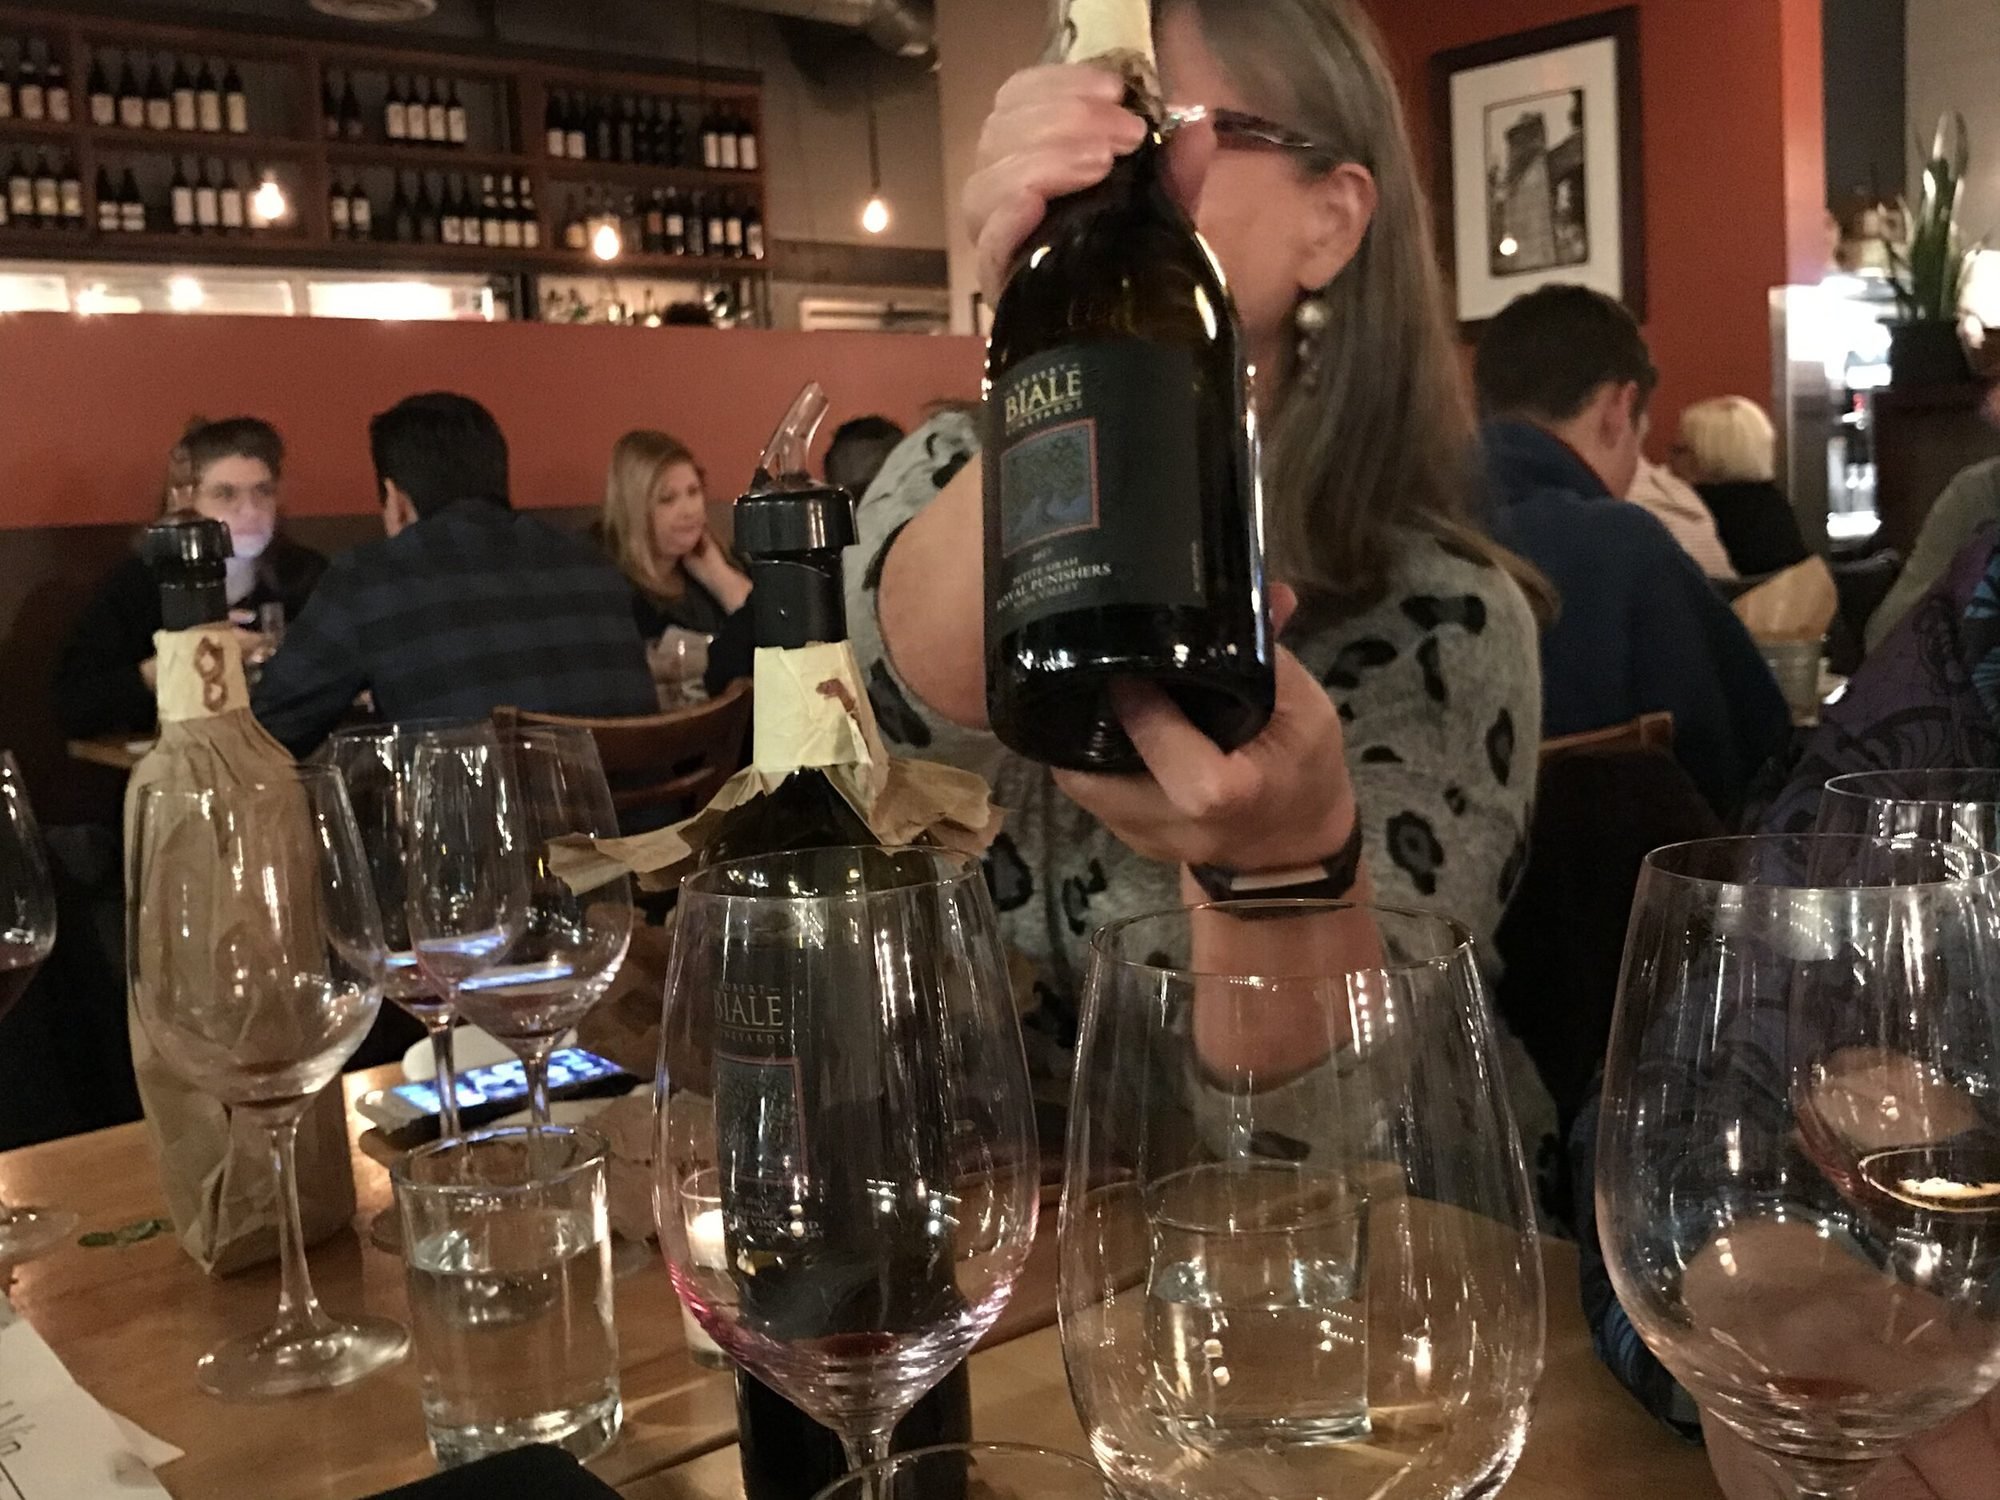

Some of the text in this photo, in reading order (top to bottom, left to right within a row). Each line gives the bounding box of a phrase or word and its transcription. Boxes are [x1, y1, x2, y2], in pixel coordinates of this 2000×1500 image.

[1005, 370, 1082, 423] BIALE
[996, 562, 1112, 612] ROYAL PUNISHERS
[194, 636, 229, 713] 8
[713, 988, 784, 1027] BIALE
[751, 1217, 820, 1230] VINEYD
